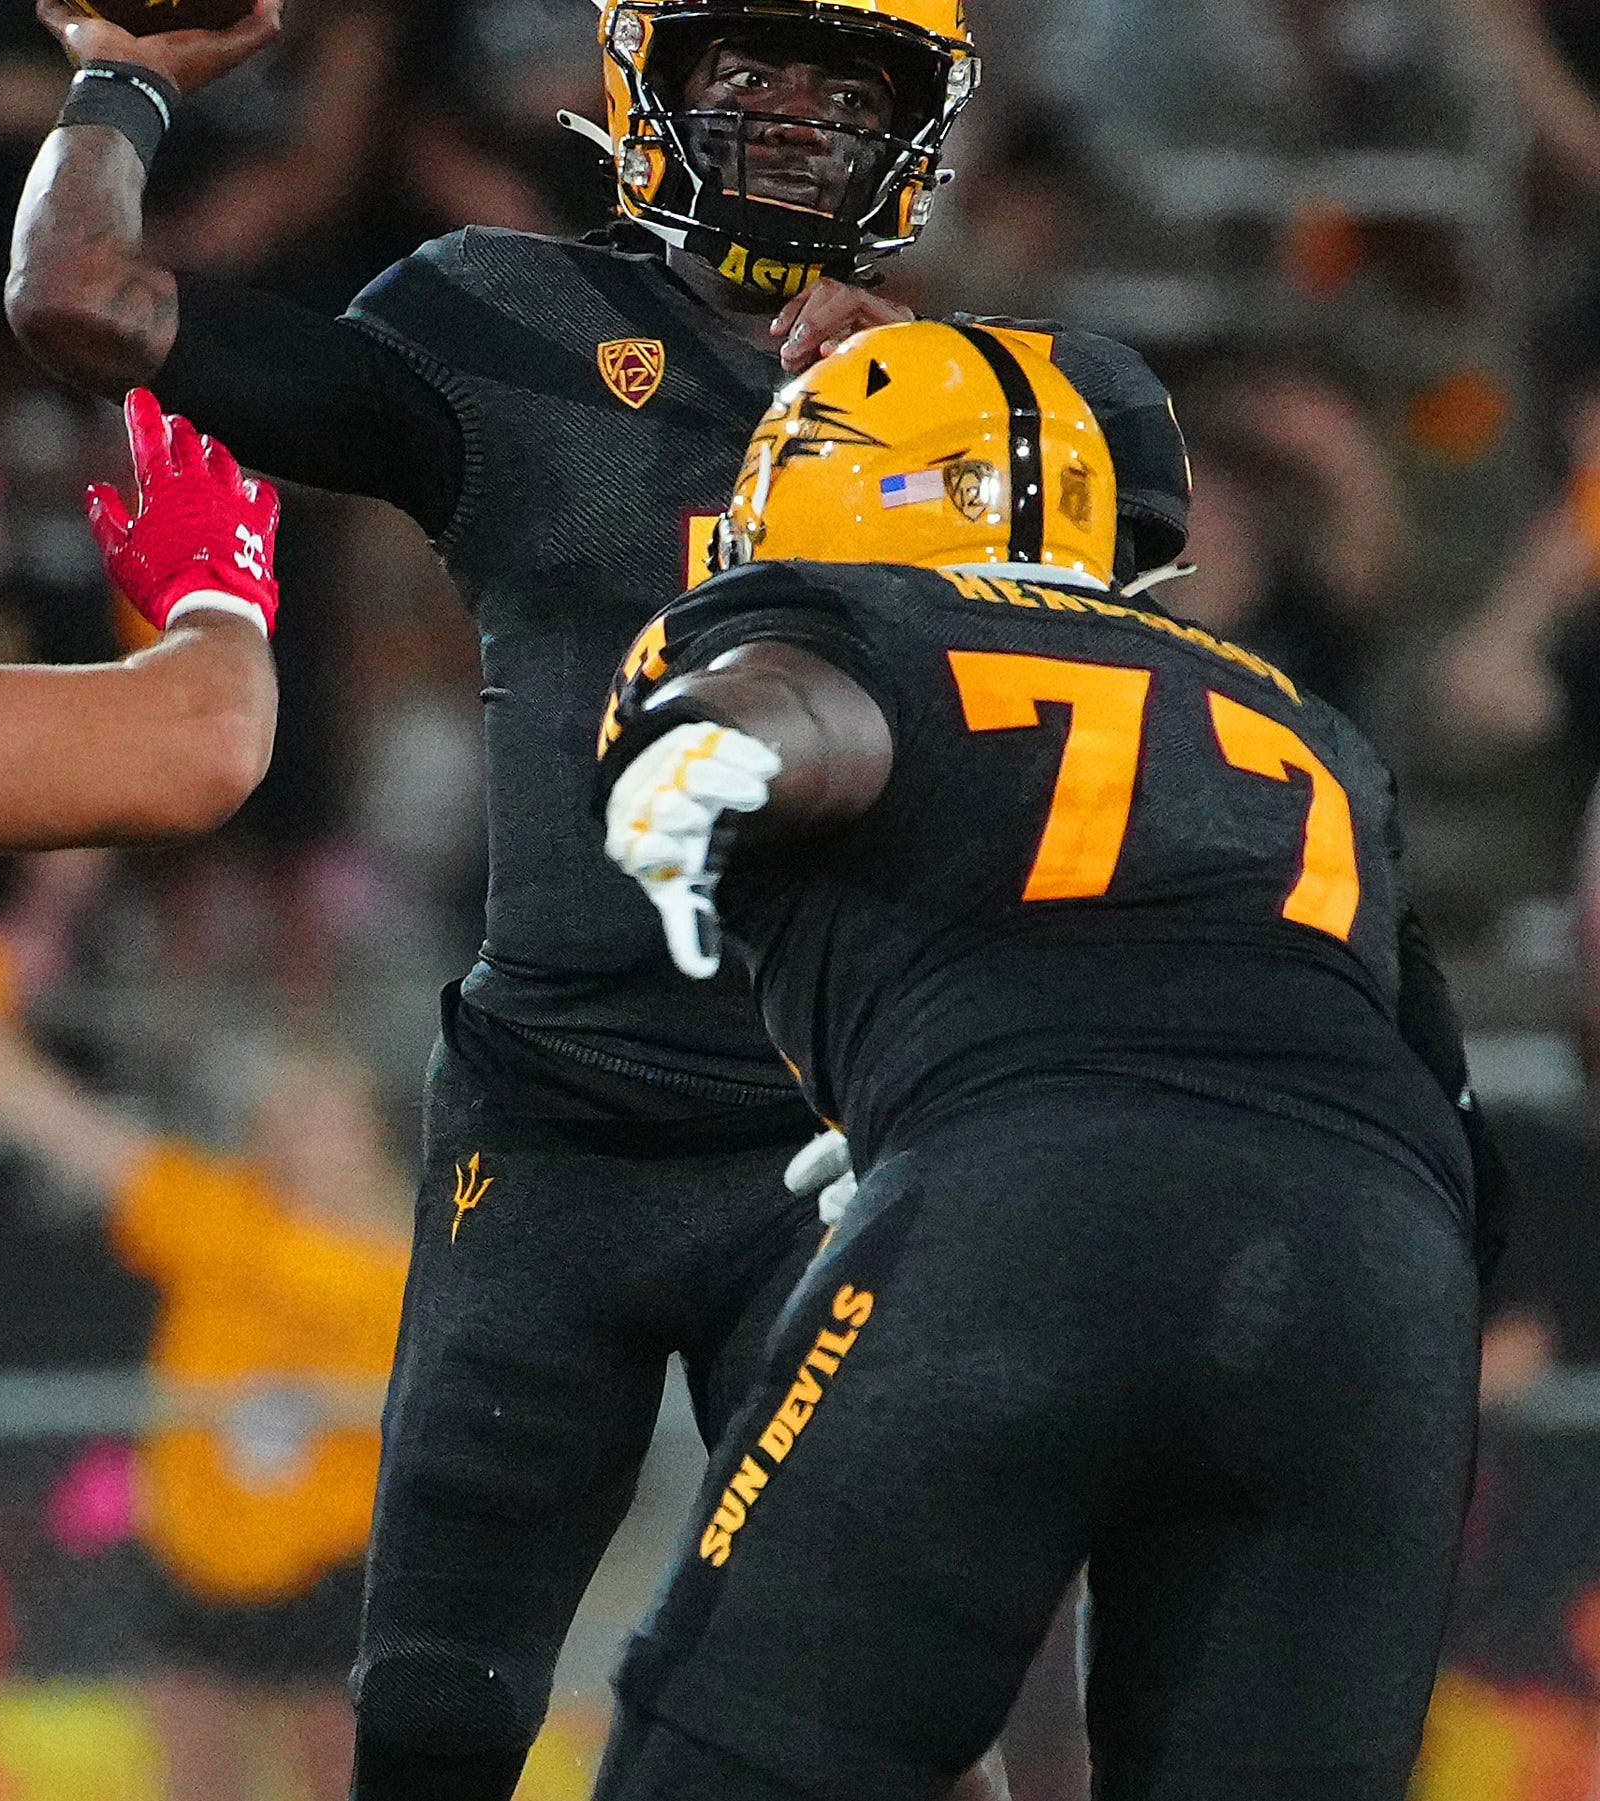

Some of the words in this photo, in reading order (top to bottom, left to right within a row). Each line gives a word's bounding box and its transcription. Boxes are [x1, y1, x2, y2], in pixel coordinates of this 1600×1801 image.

[604, 342, 660, 381] PAC
[619, 367, 653, 393] 12
[944, 648, 1362, 945] 77
[699, 1453, 770, 1569] SUN
[757, 1283, 875, 1465] DEVILS
